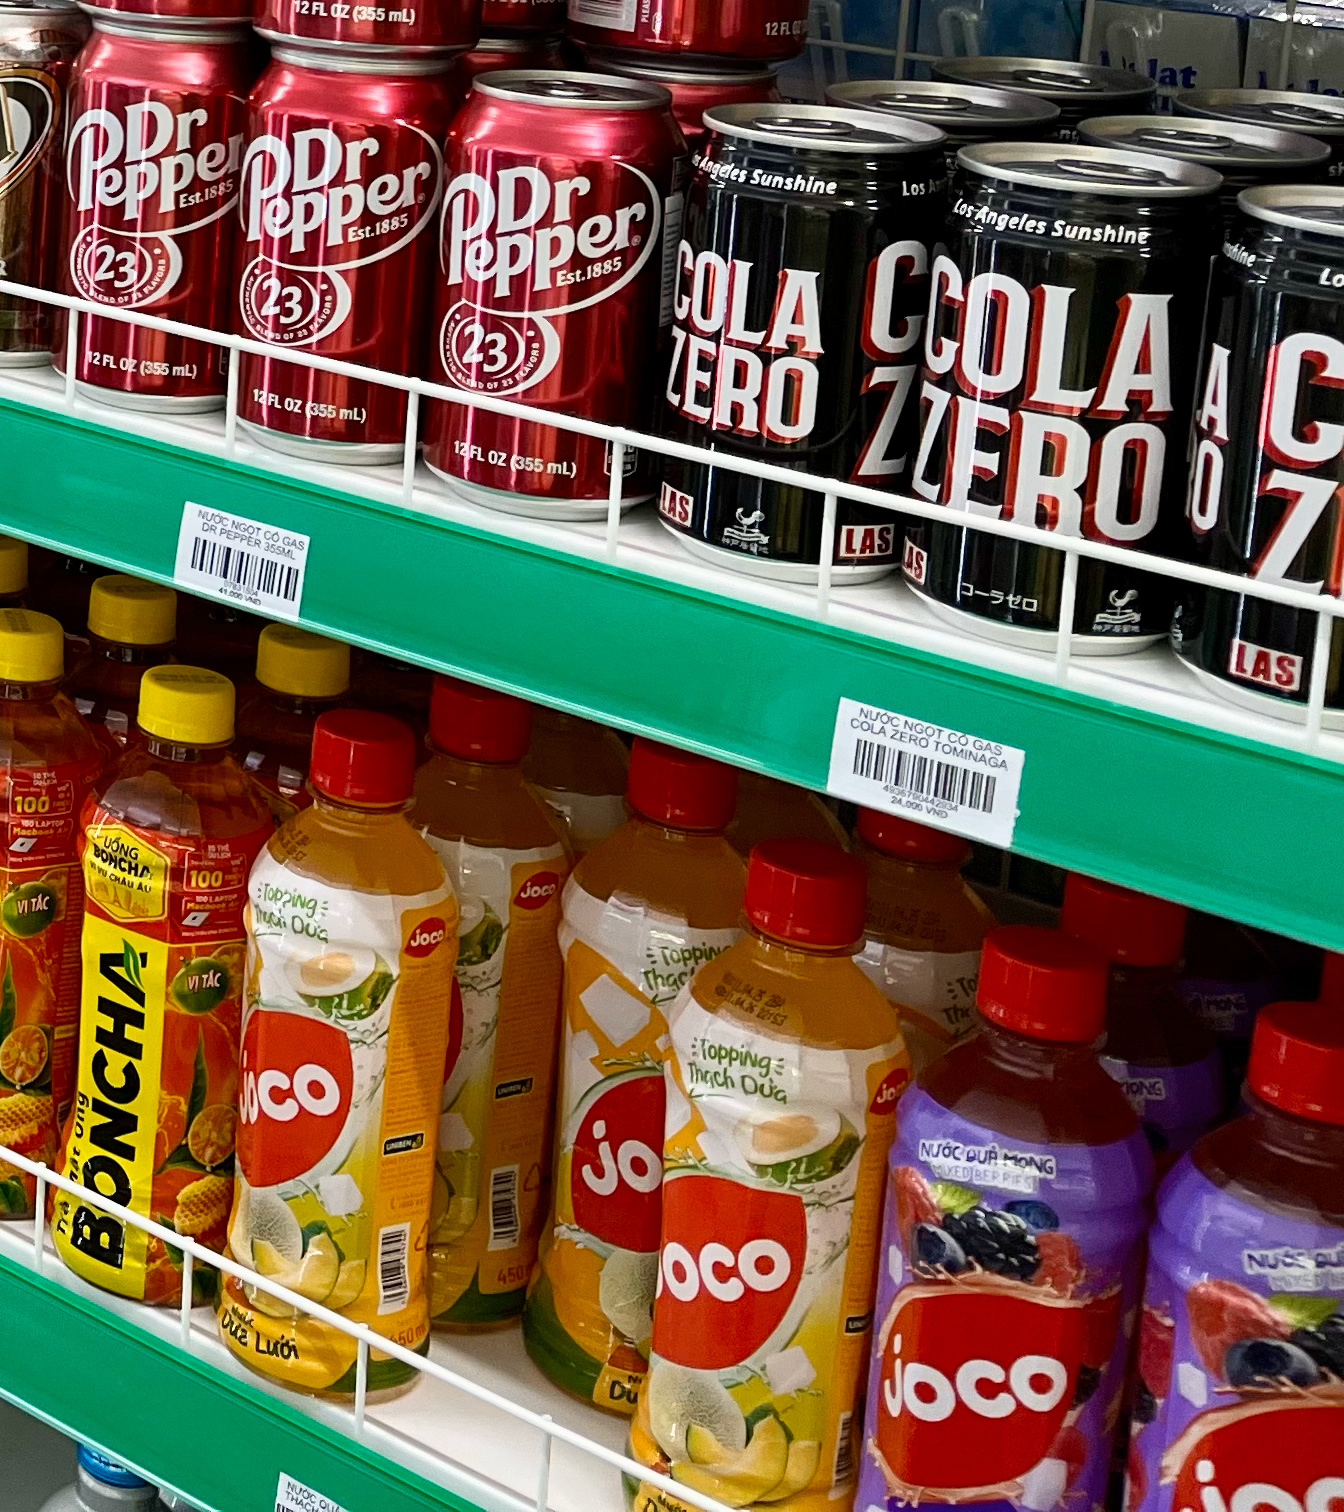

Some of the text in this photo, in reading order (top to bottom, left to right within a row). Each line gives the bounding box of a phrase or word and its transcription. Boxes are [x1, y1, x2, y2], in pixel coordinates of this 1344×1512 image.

[294, 0, 416, 25] 12 FL OZ (355 mL)
[124, 101, 208, 162] Dr
[292, 129, 379, 193] Dr
[241, 134, 432, 253] Pepper
[496, 166, 590, 234] Dr
[348, 214, 409, 243] Est.1885
[441, 173, 647, 298] Pepper
[953, 198, 1150, 246] Los Angeles Sunshine
[94, 245, 138, 289] 23
[556, 257, 623, 287] Est.1885
[260, 277, 303, 324] 23
[673, 240, 825, 355] COLA
[462, 322, 508, 374] 23
[925, 254, 1174, 417] COLA
[666, 329, 819, 443] ZERO
[339, 405, 366, 423] mL)
[453, 440, 576, 477] 12 FL OZ (355 mL)
[913, 380, 1166, 542] ZERO
[198, 509, 229, 527] NƯỚC
[230, 519, 262, 537] NGỌT
[282, 537, 305, 551] GAS
[201, 521, 296, 560] DR PEPPER 355ML
[844, 528, 892, 555] LAS
[961, 583, 1038, 612] コーラゼロ
[1235, 641, 1297, 690] LAS
[850, 718, 1009, 771] COLA ZERO TOMINAGA
[859, 706, 900, 728] NƯỚC
[904, 719, 945, 741] NGỌT
[972, 740, 1003, 756] GAS
[926, 805, 949, 819] VND
[91, 846, 153, 878] BONCHA
[188, 868, 224, 889] 100
[187, 970, 222, 993] VỊ TẮC
[700, 1038, 772, 1078] Topping
[240, 1050, 341, 1125] joco
[883, 1335, 1069, 1423] joco
